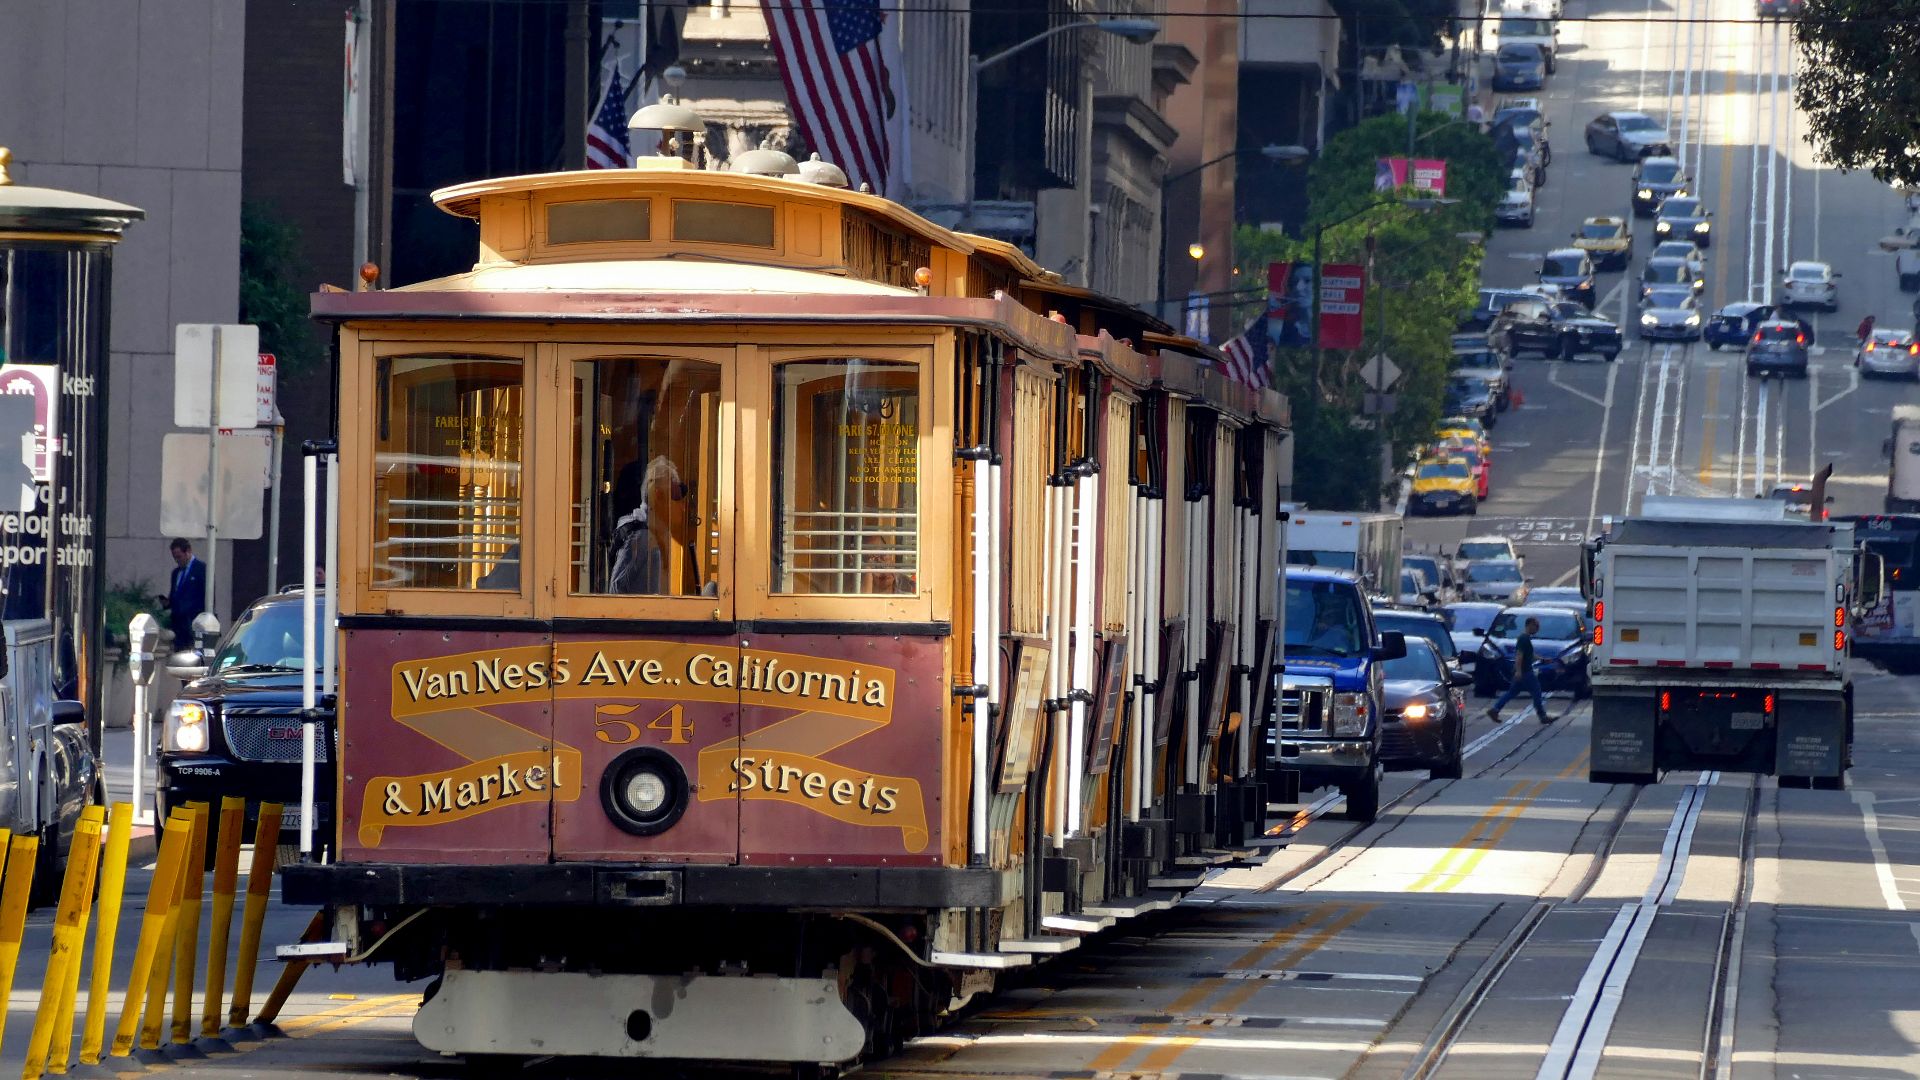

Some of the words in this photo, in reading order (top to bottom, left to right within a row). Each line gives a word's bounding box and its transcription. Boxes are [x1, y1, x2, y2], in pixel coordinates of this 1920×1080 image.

[61, 513, 92, 536] that
[0, 543, 93, 567] poration
[400, 667, 470, 702] Van
[471, 657, 571, 694] Ness
[686, 653, 887, 708] California
[594, 703, 695, 744] 54
[178, 767, 193, 775] TCP
[382, 781, 413, 816] &
[417, 755, 563, 817] Market
[728, 756, 900, 815] Streets
